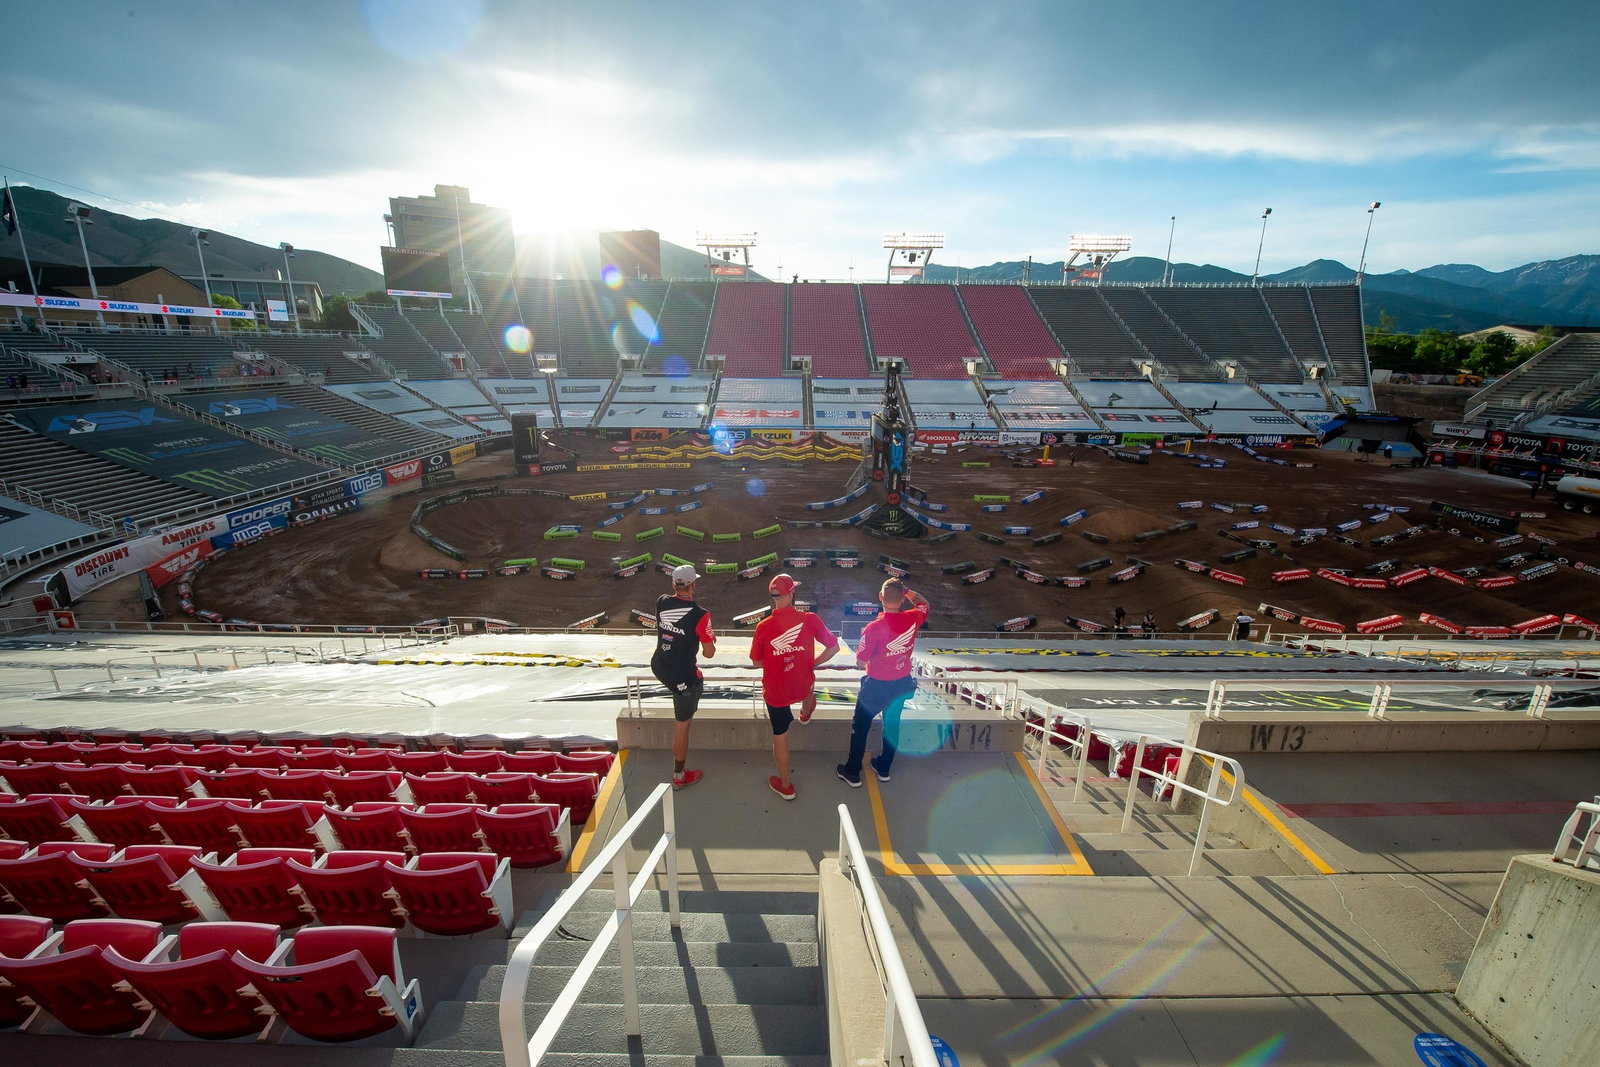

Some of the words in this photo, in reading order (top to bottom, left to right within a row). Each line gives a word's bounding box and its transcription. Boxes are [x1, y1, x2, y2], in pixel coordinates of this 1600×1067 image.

[44, 298, 81, 308] SUZUKI
[108, 302, 139, 311] SUZUKI
[169, 305, 195, 314] SUZUKI
[1302, 412, 1329, 422] cbdMD
[635, 431, 662, 441] KTM
[752, 431, 792, 441] SUZUKI
[1254, 435, 1282, 443] YAMAHA
[1507, 436, 1542, 447] TOYOTA
[224, 457, 297, 477] MONSTER
[541, 463, 567, 472] TOYOTA
[350, 473, 383, 495] WPS
[310, 491, 326, 501] UTAH
[326, 486, 344, 497] SPORTS
[574, 493, 603, 501] SUZUKI
[230, 500, 292, 528] COOPER
[311, 499, 357, 518] OAKLEY
[1452, 509, 1501, 526] MONSTER
[162, 521, 216, 546] AMERICA'S
[74, 546, 130, 577] DISCOUNT
[161, 547, 201, 572] FLY
[92, 564, 116, 580] TIRE
[1403, 573, 1428, 584] HONDA
[1221, 576, 1244, 586] HONDA
[1443, 573, 1465, 586] HONDA
[1491, 579, 1514, 588] HONDA
[658, 621, 686, 636] HONDA
[1315, 624, 1342, 634] HONDA
[1374, 621, 1404, 633] HONDA
[1435, 621, 1459, 634] HONDA
[1529, 621, 1560, 634] HONDA
[772, 645, 806, 656] HONDA
[886, 644, 914, 657] HONDA
[937, 724, 961, 750] W
[970, 724, 992, 750] 14
[1250, 724, 1275, 752] W
[1280, 724, 1306, 752] 13
